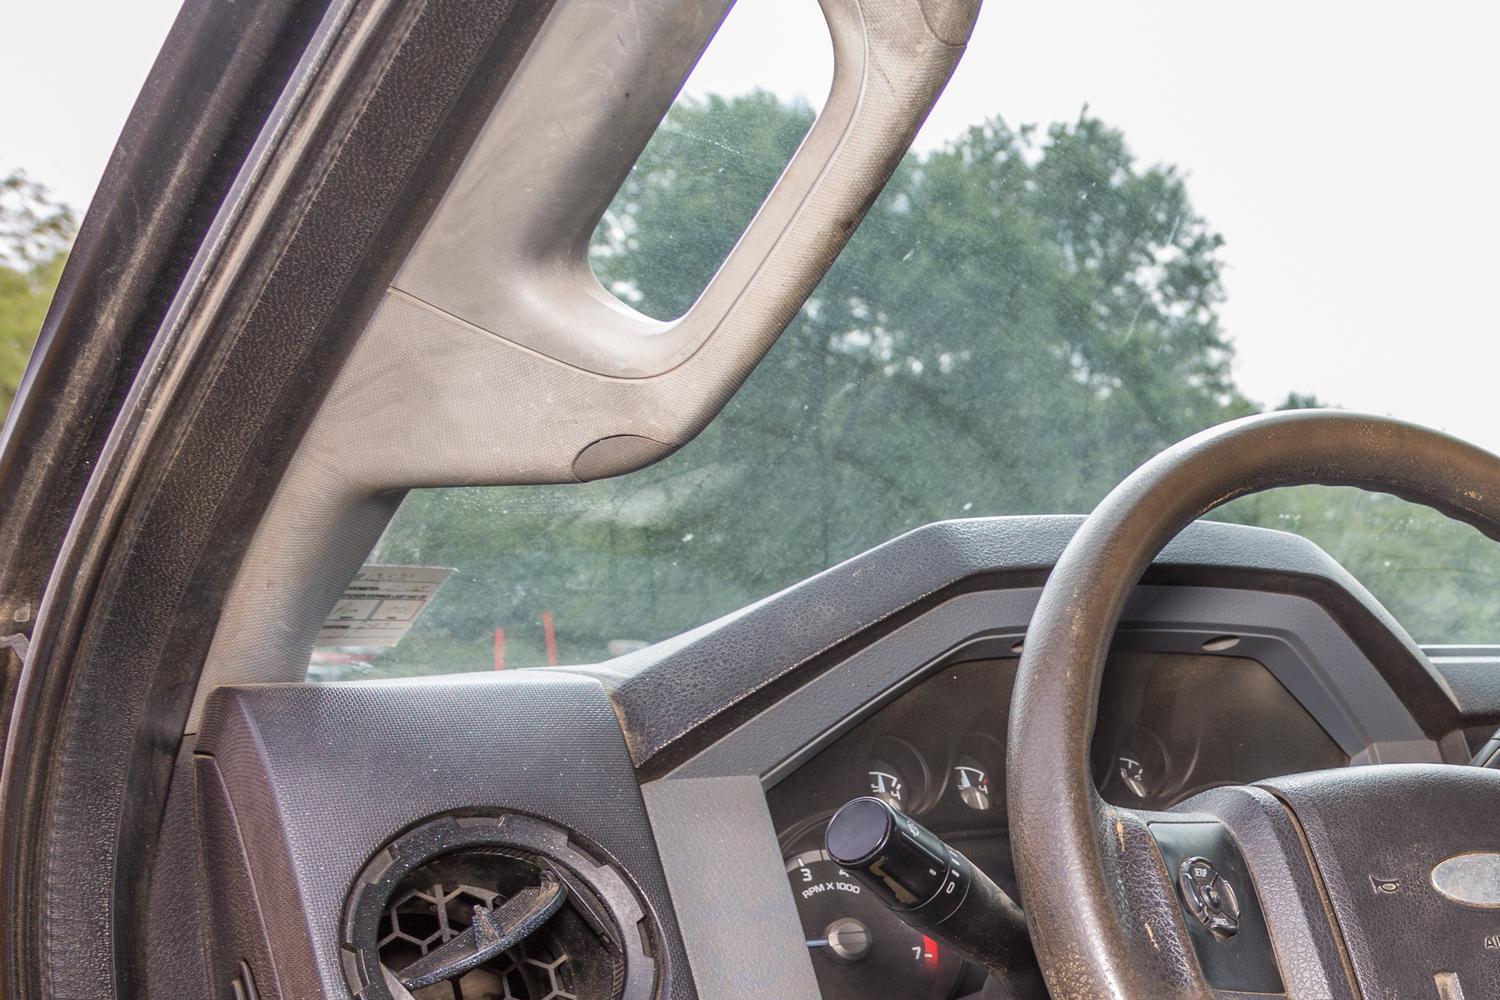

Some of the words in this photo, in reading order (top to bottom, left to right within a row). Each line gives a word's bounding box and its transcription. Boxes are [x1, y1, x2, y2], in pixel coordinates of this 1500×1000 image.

[800, 868, 813, 882] 3
[802, 884, 826, 899] RPM
[826, 882, 836, 890] X
[836, 881, 861, 894] 1000
[911, 946, 922, 960] 7
